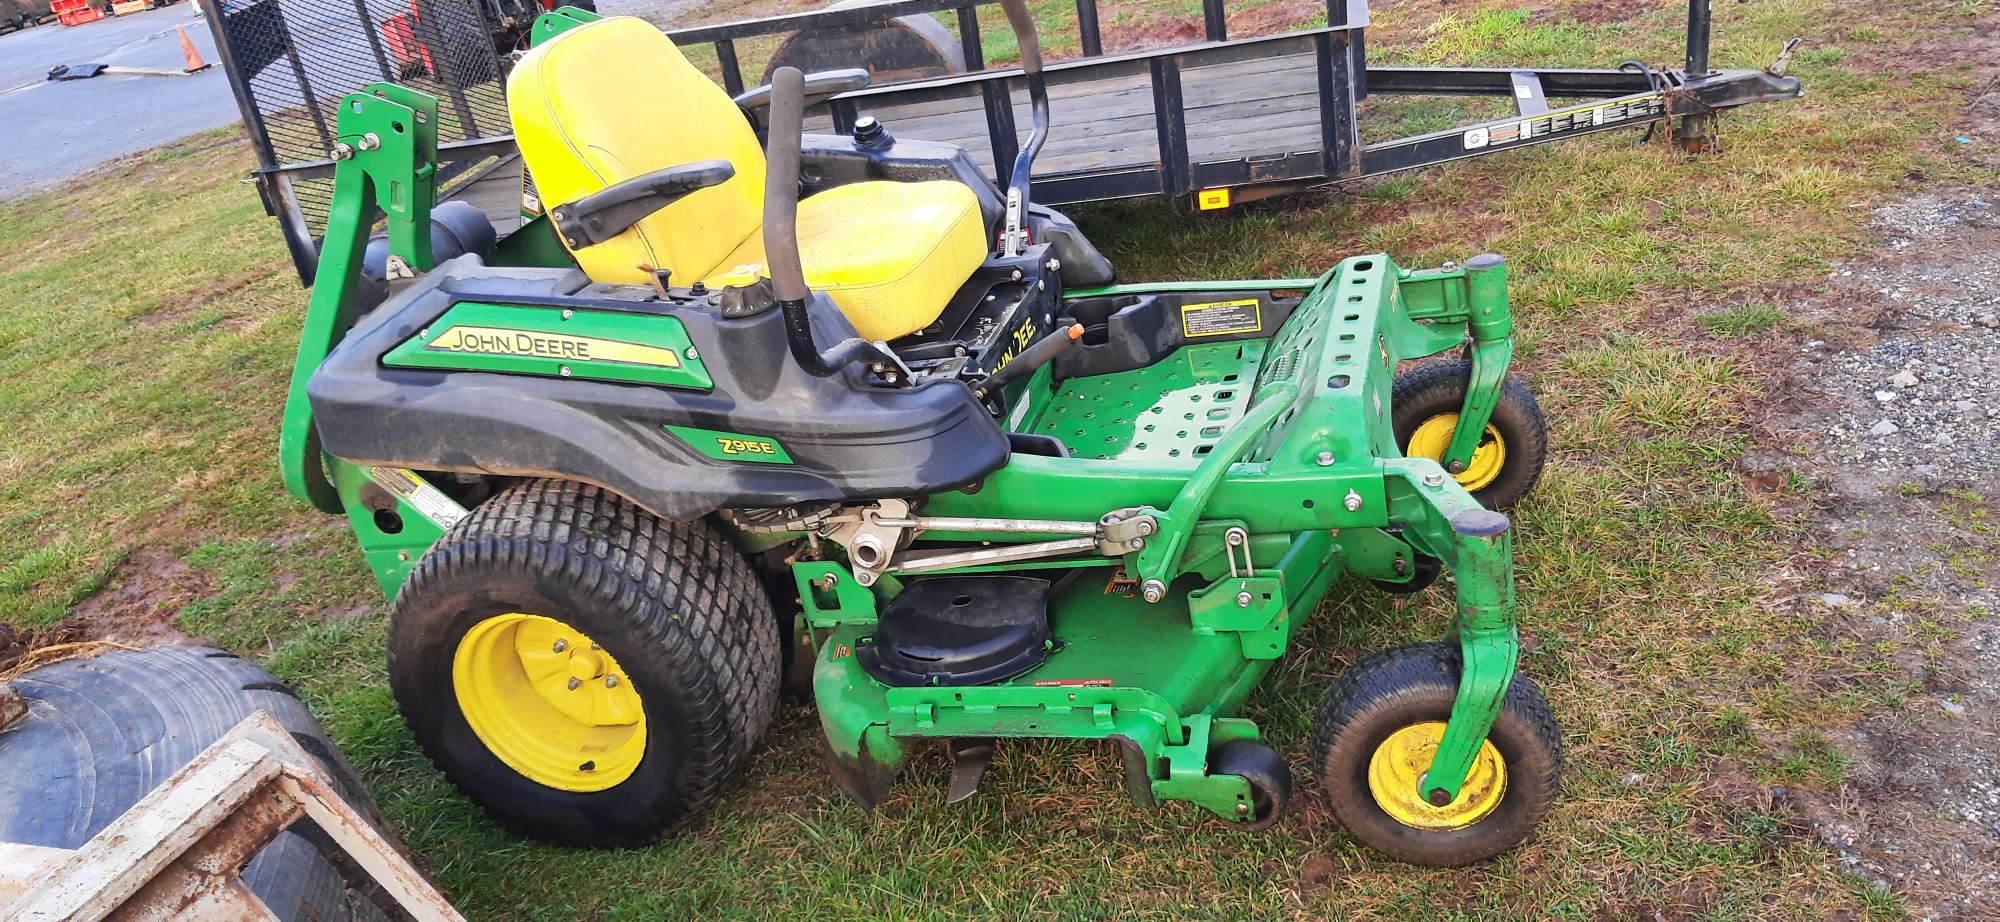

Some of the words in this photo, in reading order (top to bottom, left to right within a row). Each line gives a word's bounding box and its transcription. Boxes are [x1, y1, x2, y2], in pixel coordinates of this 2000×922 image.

[453, 331, 510, 351] JOHN
[516, 334, 590, 357] DEERE
[717, 438, 776, 455] Z915E
